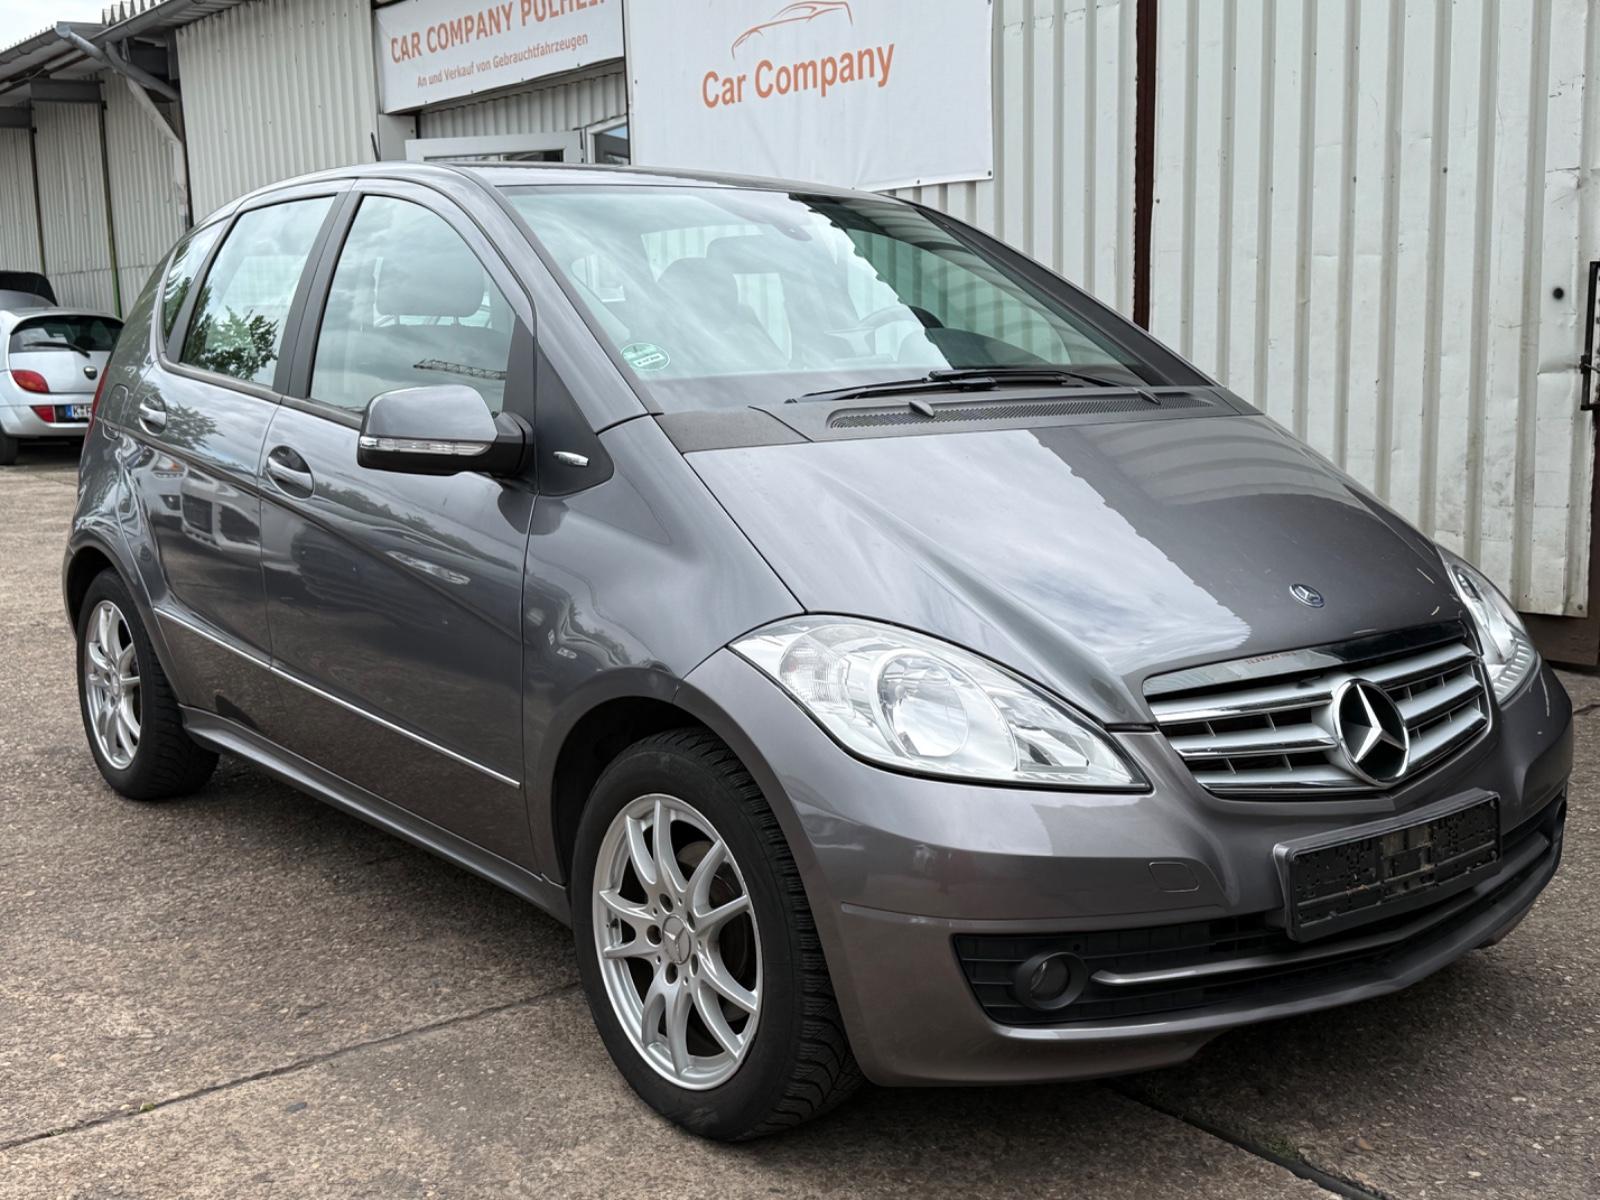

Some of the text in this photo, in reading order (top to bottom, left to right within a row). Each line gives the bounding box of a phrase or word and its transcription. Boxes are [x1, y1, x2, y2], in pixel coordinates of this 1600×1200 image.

[391, 31, 422, 64] CAR
[426, 1, 513, 53] COMPANY
[417, 32, 588, 88] An und Verkauf von Gebrauchtfahrzeugen
[702, 43, 895, 108] Car Company
